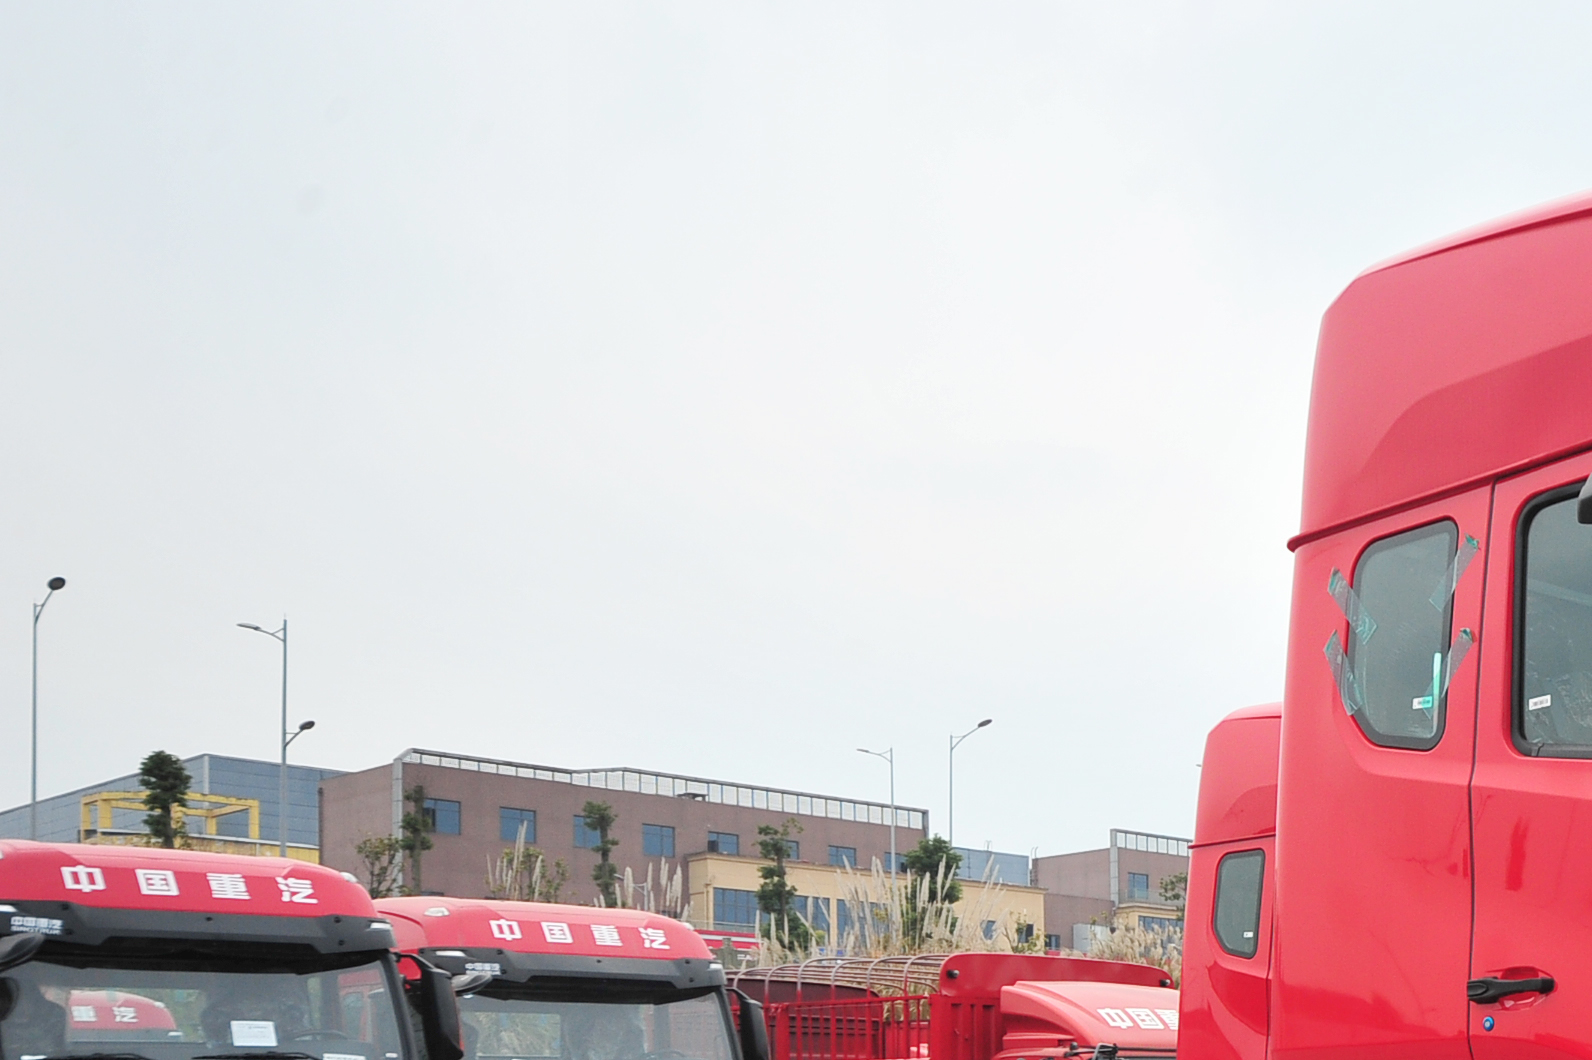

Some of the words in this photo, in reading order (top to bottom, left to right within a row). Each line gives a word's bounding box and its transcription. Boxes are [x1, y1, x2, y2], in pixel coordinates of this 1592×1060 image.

[60, 865, 319, 904] 中国重汽
[489, 918, 671, 950] 中国重汽
